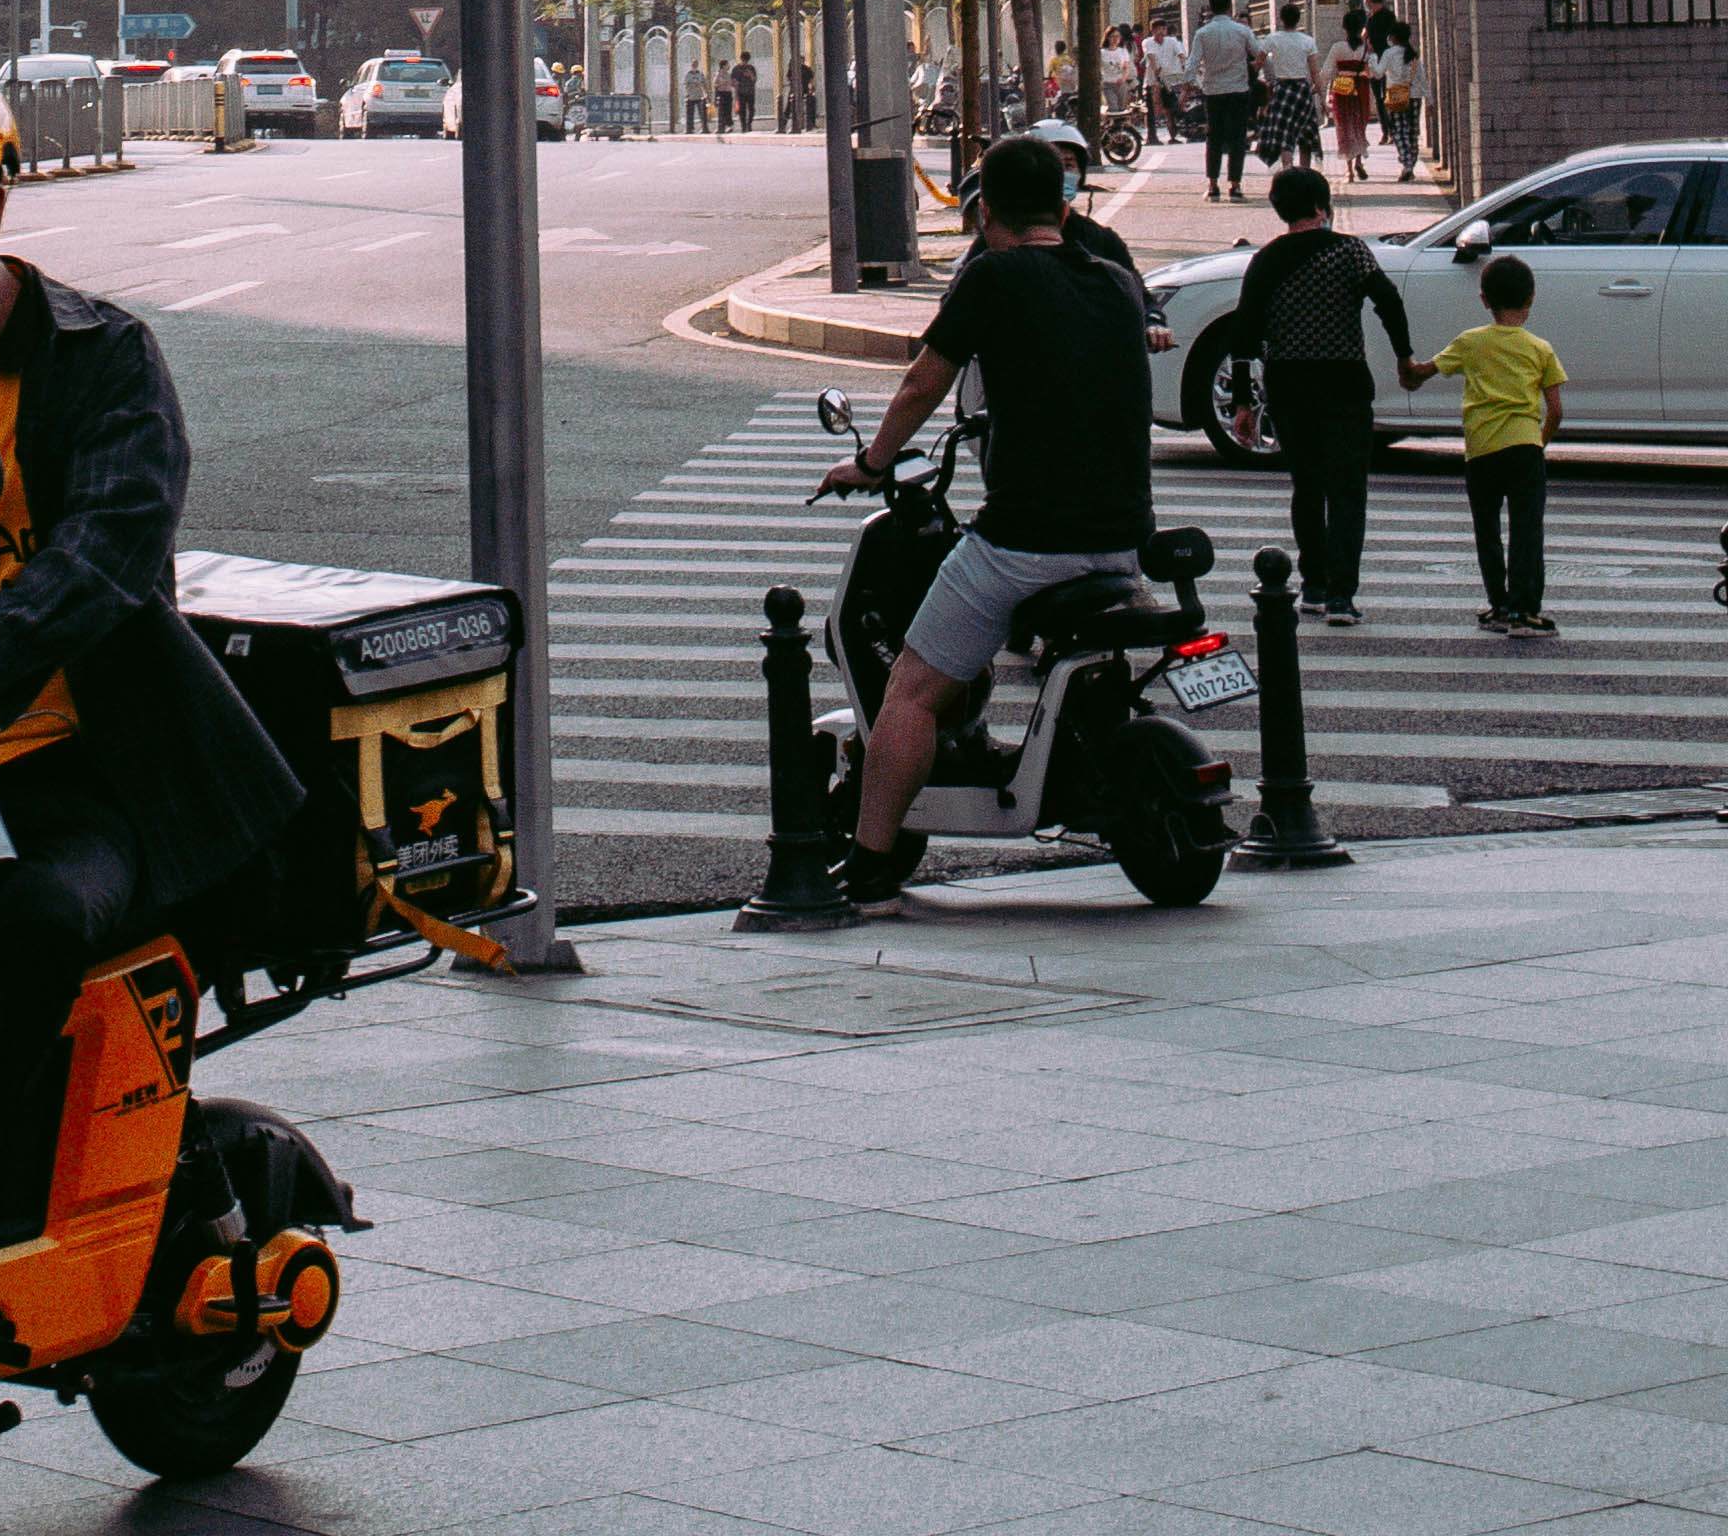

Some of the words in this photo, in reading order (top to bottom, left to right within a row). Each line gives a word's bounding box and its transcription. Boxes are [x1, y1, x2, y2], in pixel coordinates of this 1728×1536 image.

[361, 613, 491, 662] A2008637-036
[1183, 671, 1249, 703] H07252
[397, 834, 459, 871] 美团外卖
[122, 1082, 158, 1107] NEW
